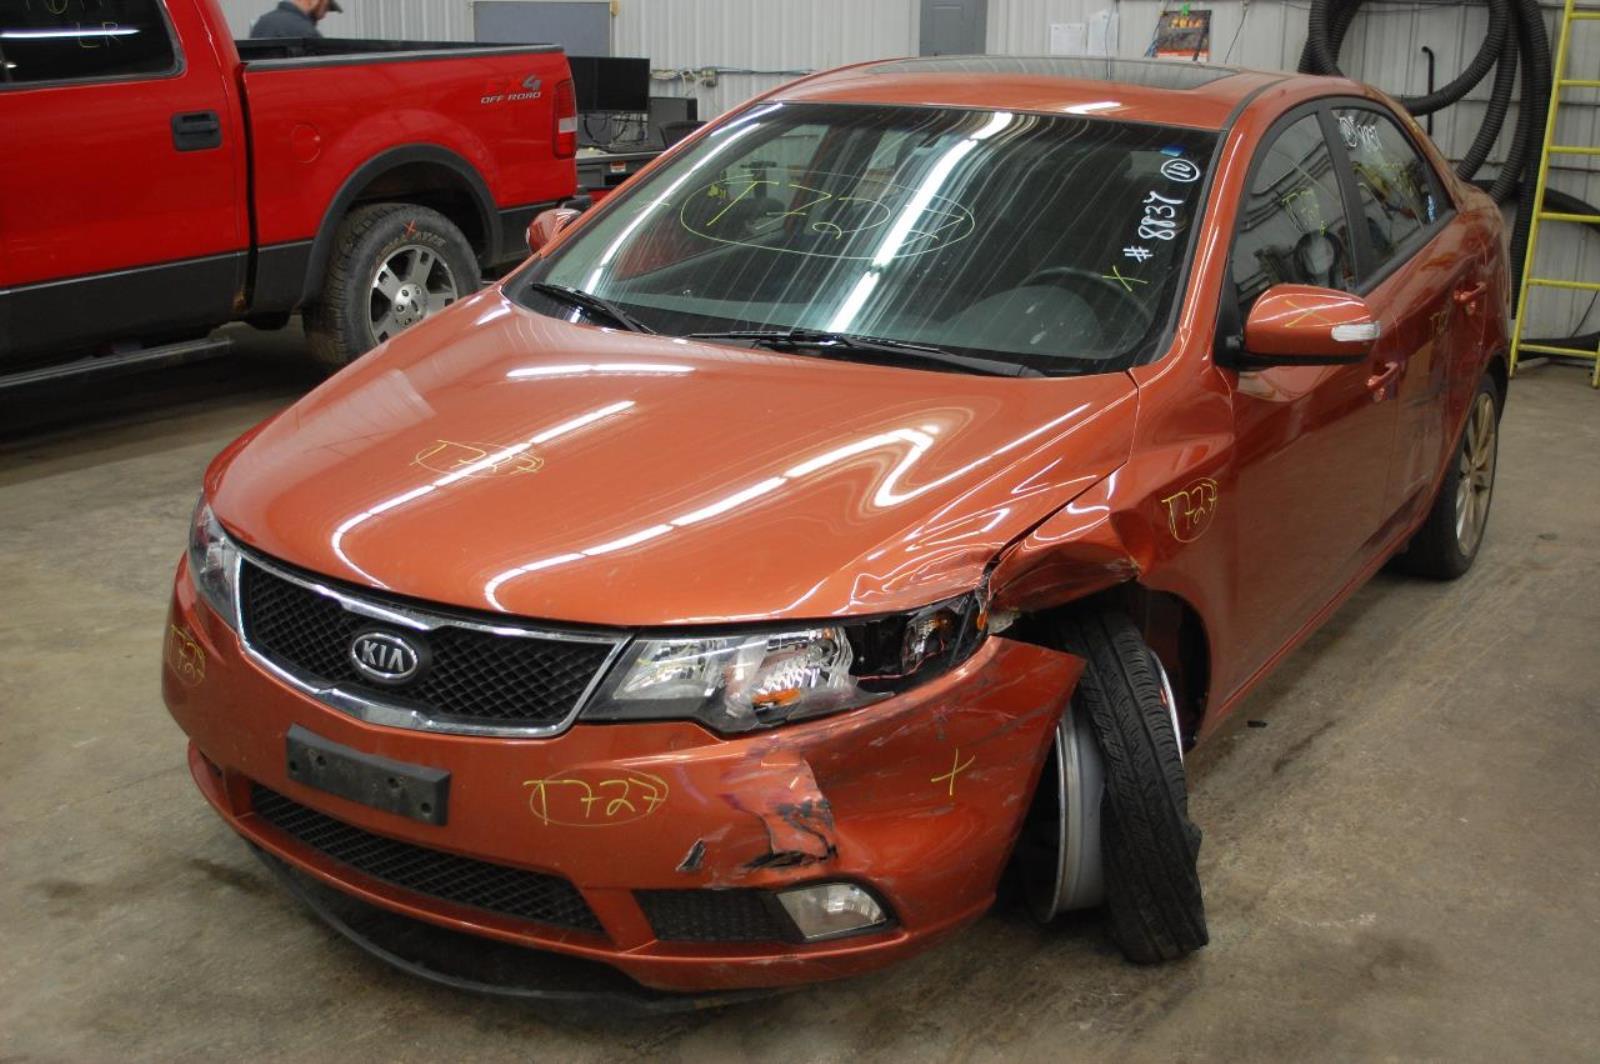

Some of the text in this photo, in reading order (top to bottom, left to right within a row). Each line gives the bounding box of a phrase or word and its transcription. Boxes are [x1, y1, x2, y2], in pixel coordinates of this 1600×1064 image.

[480, 91, 542, 105] OFF ROAD
[362, 639, 405, 672] KIA
[523, 777, 660, 826] T727
